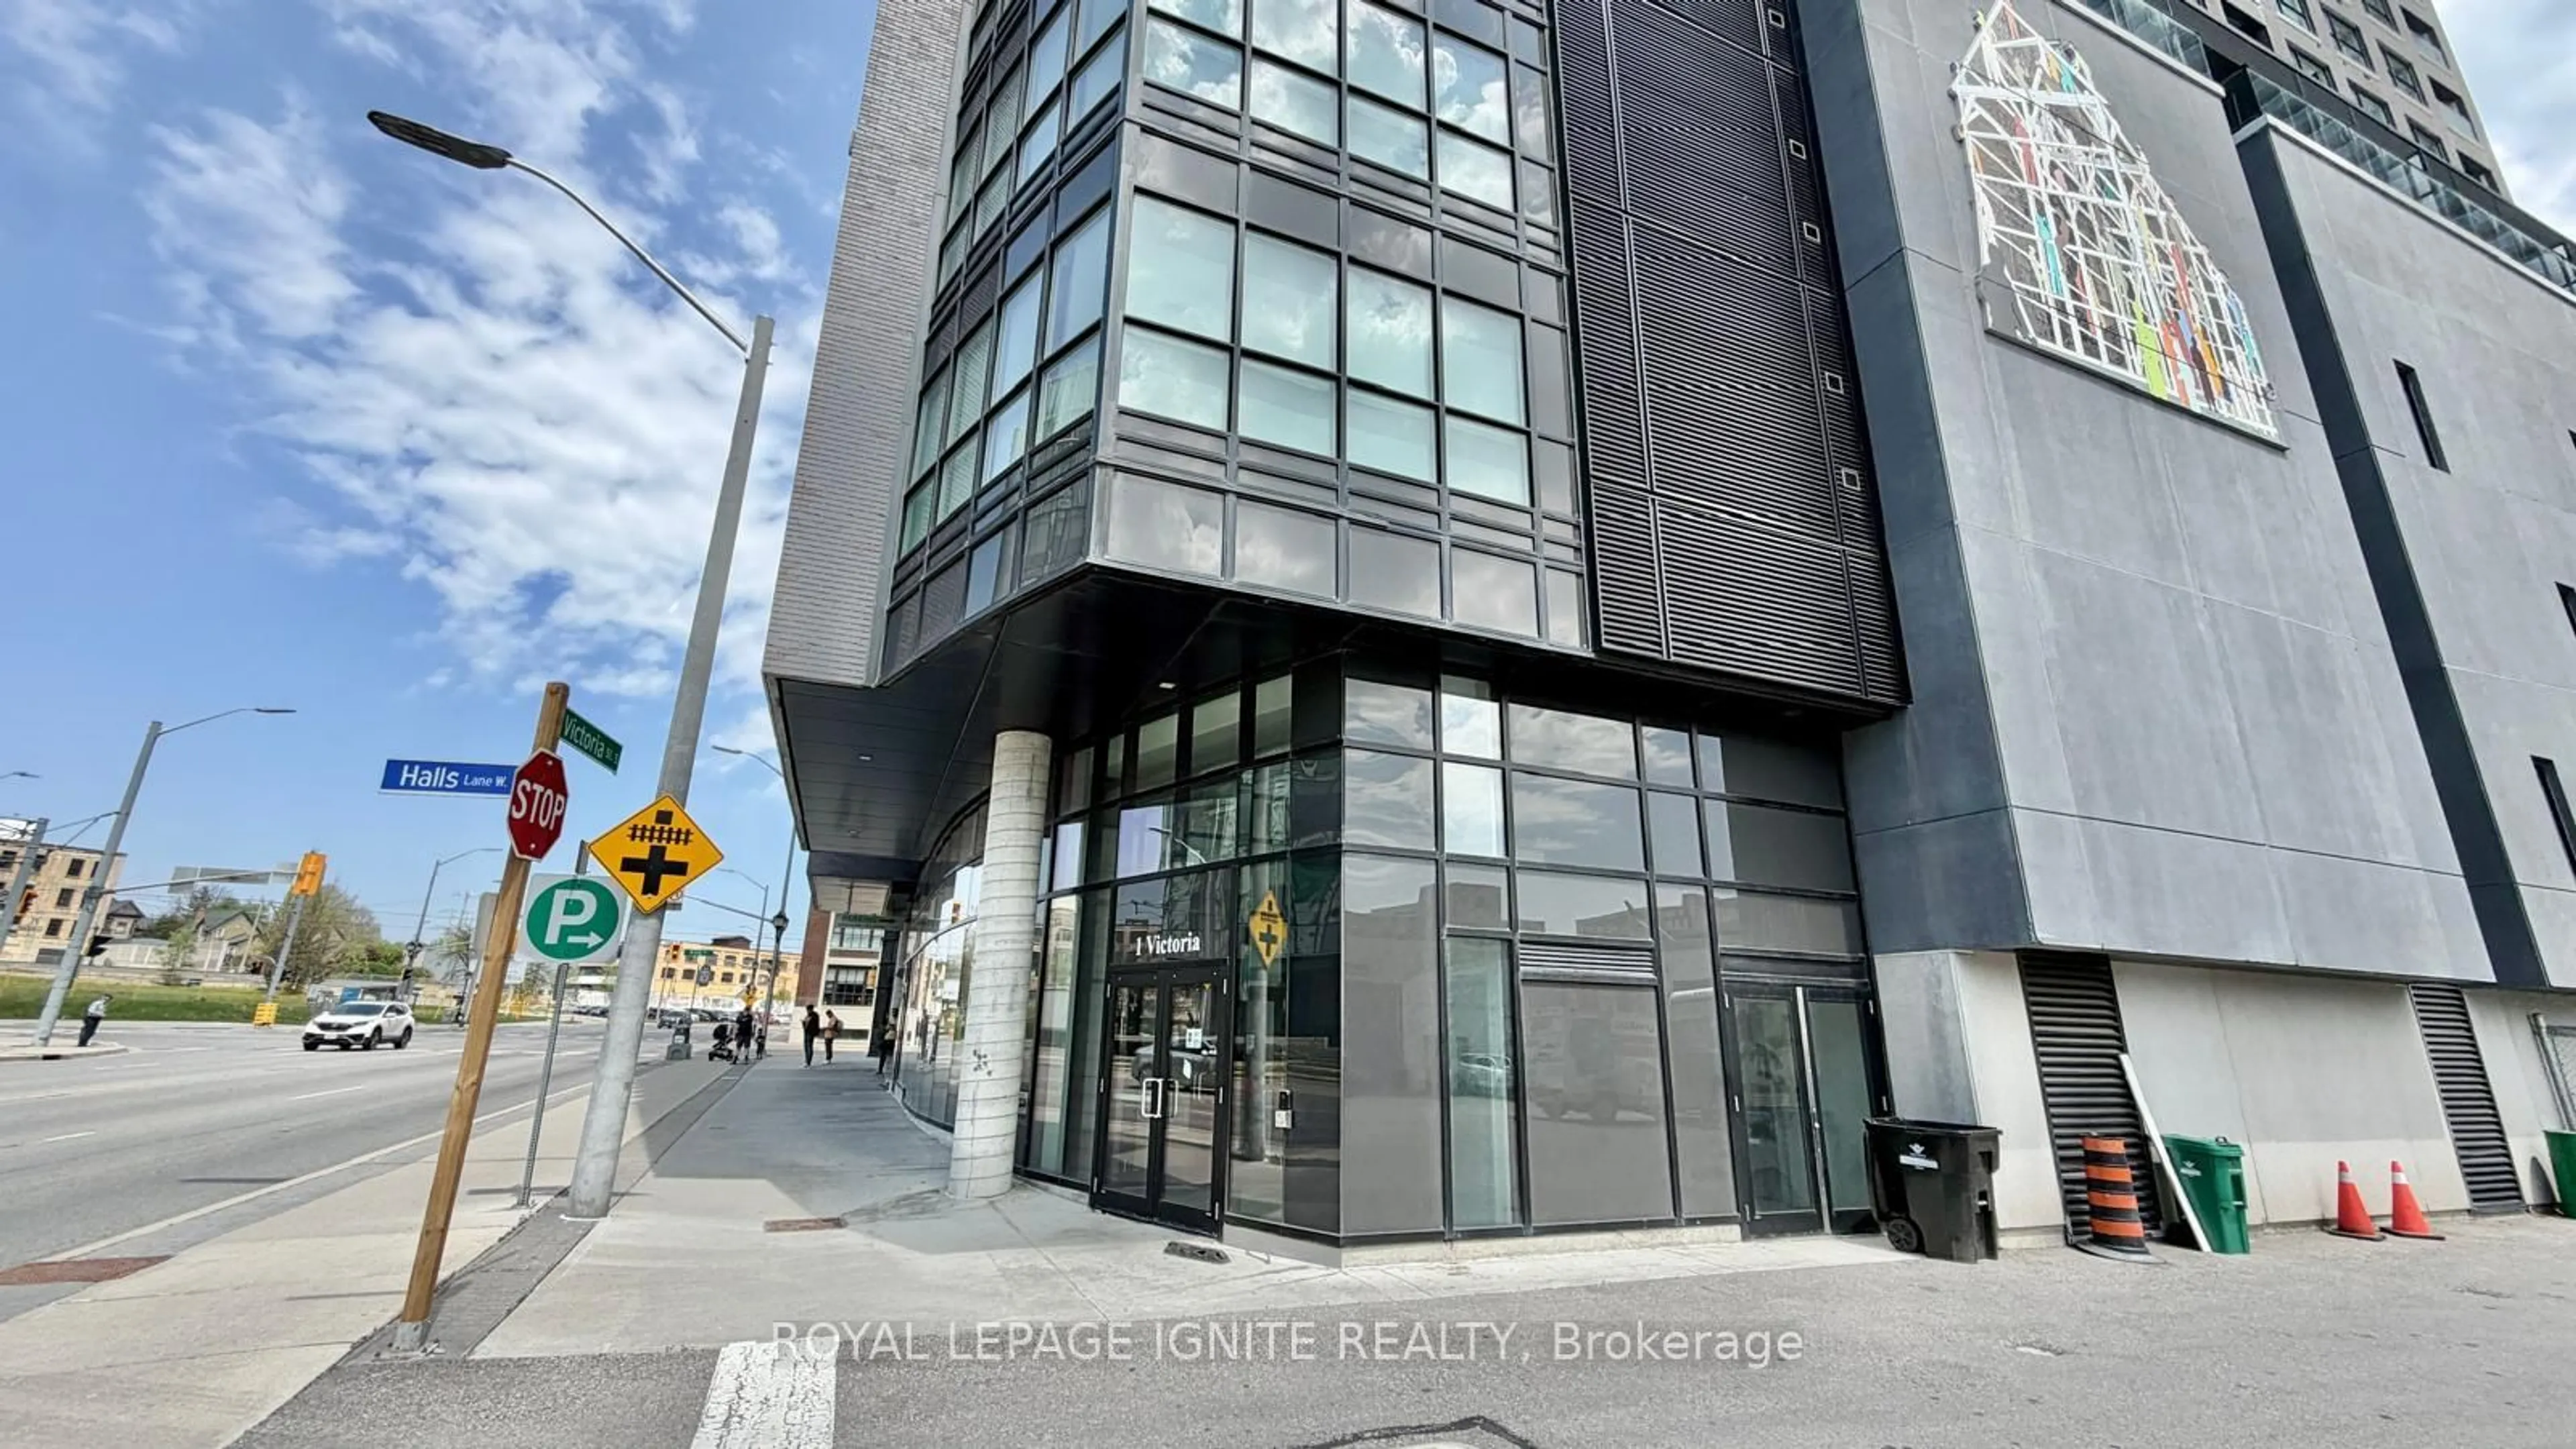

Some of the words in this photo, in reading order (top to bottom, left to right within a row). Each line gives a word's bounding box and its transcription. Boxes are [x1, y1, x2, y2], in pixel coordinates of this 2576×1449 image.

[564, 714, 605, 759] Victoria
[399, 764, 459, 788] Halls
[463, 774, 492, 787] Lane
[512, 779, 565, 830] STOP
[544, 889, 597, 945] P
[1135, 936, 1142, 956] 1
[1146, 931, 1200, 955] Victoria
